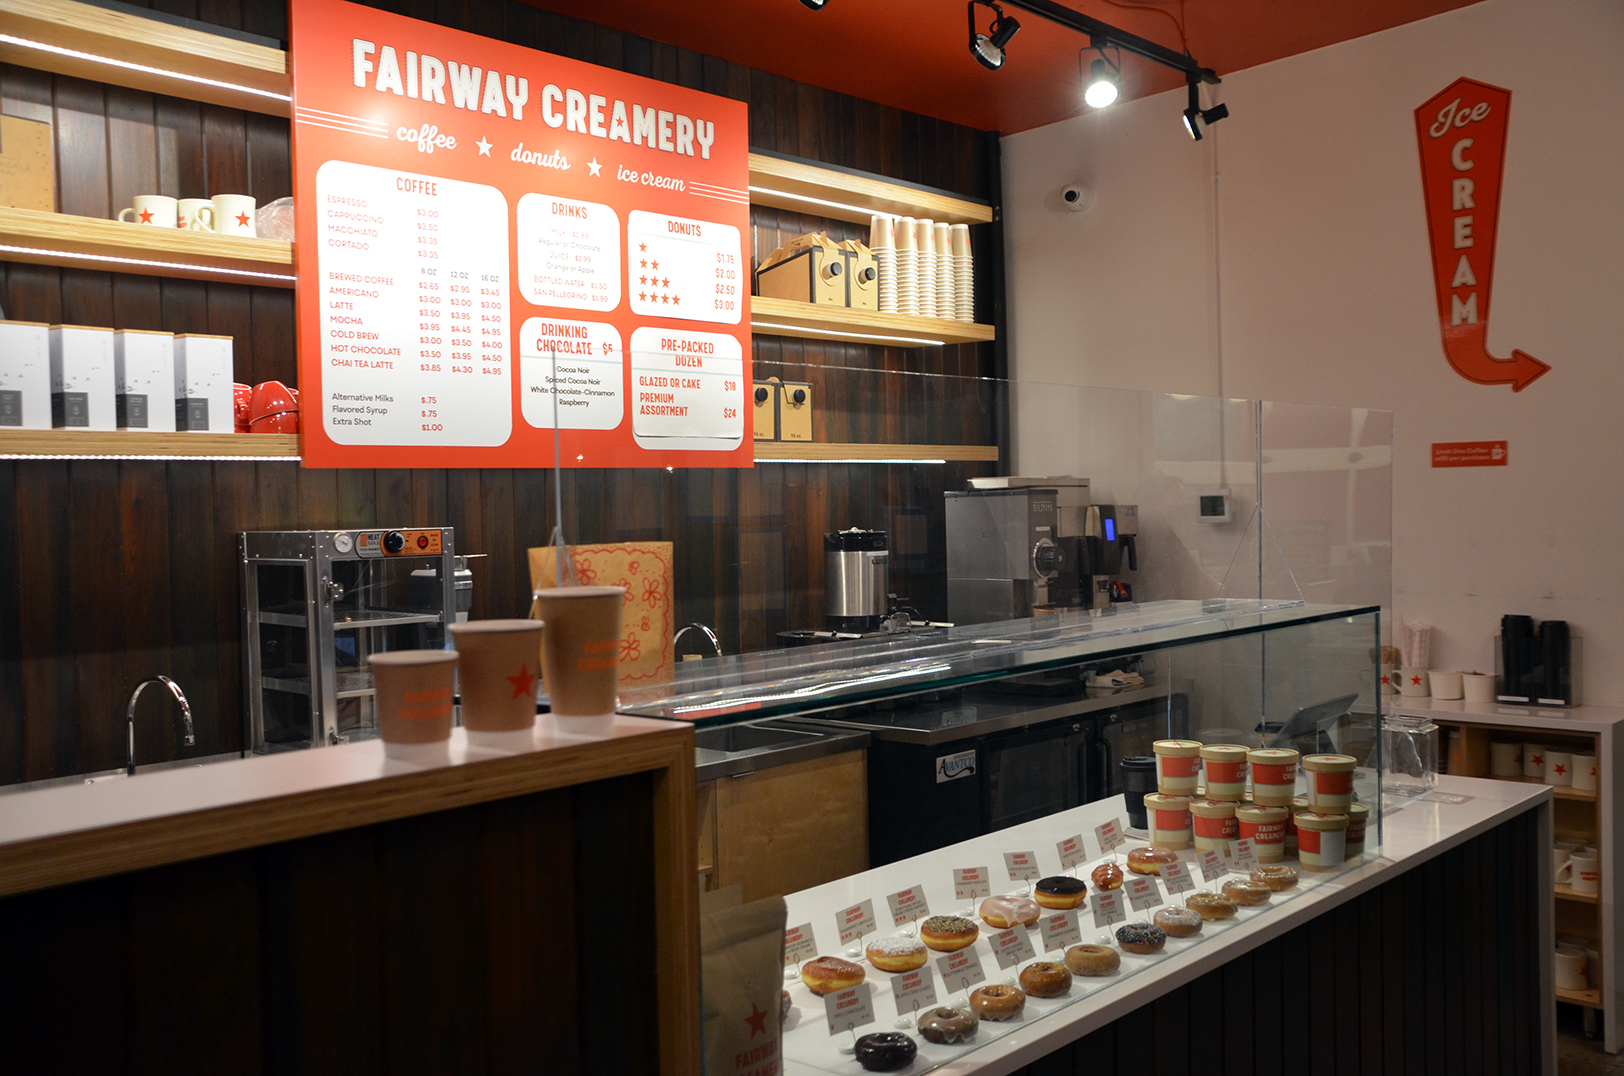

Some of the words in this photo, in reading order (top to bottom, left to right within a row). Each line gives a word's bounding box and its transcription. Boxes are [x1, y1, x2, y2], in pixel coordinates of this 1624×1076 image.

[352, 37, 529, 121] FAIRWAY
[542, 83, 715, 160] CREAMERY
[1429, 97, 1492, 138] Ice
[396, 123, 457, 154] coffee
[510, 142, 571, 171] donuts
[617, 164, 639, 184] ice
[641, 171, 686, 192] cream
[397, 177, 437, 196] COFFEE
[328, 195, 368, 208] ESPRESSO
[417, 209, 439, 218] $3.00
[552, 202, 588, 220] DRINKS
[328, 210, 384, 224] CAPPUCCINO
[418, 222, 438, 232] $3.50
[668, 220, 702, 237] DONUTS
[328, 225, 378, 237] MACCHIATO
[418, 236, 438, 245] $3.35
[1450, 137, 1479, 327] CREAM
[328, 239, 369, 250] CORTADO
[418, 250, 438, 259] $3.35
[575, 254, 592, 263] $1.99
[716, 253, 734, 264] $1.75
[427, 268, 437, 276] OZ
[481, 274, 489, 282] 16
[534, 275, 562, 286] BOTTLED
[563, 278, 585, 288] WATER
[715, 268, 735, 280] $2.00
[329, 272, 362, 283] BREWED
[364, 275, 394, 286] COFFEE
[418, 282, 439, 290] $2.65
[450, 285, 470, 293] $2.95
[481, 288, 500, 296] $3.45
[715, 284, 735, 295] $2.50
[329, 287, 379, 298] AMERICANO
[419, 295, 441, 304] $3.00
[451, 298, 472, 307] $3.00
[481, 301, 502, 310] $3.00
[549, 289, 588, 300] PELLEGRINO
[330, 301, 354, 310] LATTE
[419, 309, 440, 318] $3.50
[451, 312, 470, 320] $3.95
[481, 314, 501, 323] $4.50
[714, 299, 734, 310] $3.00
[330, 316, 363, 325] MOCHA
[419, 323, 440, 331] $3.95
[451, 326, 471, 334] $4.45
[482, 328, 501, 336] $4.95
[541, 323, 588, 339] DRINKING
[330, 330, 355, 339] COLD
[357, 332, 379, 340] BREW
[420, 336, 442, 345] $3.00
[451, 339, 472, 347] $3.50
[482, 341, 502, 349] $4.00
[536, 338, 592, 355] CHOCOLATE
[661, 338, 714, 354] PRE-PACKED
[331, 344, 348, 353] HOT
[350, 346, 401, 356] CHOCOLATE
[420, 350, 441, 358] $3.50
[452, 352, 472, 360] $3.95
[482, 354, 502, 362] $4.50
[675, 354, 702, 368] DOZEN
[331, 358, 353, 367] CHAI
[355, 360, 368, 368] TEA
[370, 361, 394, 369] LATTE
[420, 364, 441, 372] $3.85
[452, 365, 473, 374] $4.30
[482, 367, 502, 375] $4.95
[557, 366, 576, 374] Cocoa
[578, 366, 590, 374] Noir
[545, 376, 566, 385] Spiced
[568, 377, 586, 385] Cocoa
[588, 378, 601, 386] Noir
[639, 376, 668, 387] GLAZED
[670, 377, 680, 388] OR
[682, 378, 700, 389] CAKE
[724, 381, 736, 391] $18
[332, 393, 374, 402] Alternative
[375, 394, 394, 402] Milks
[530, 386, 548, 394] White
[550, 387, 615, 397] Chocolate-Cinnamon
[640, 392, 674, 403] PREMIUM
[332, 405, 364, 414] Flavored
[366, 406, 388, 416] Syrup
[559, 399, 589, 408] Raspberry
[640, 404, 688, 417] ASSORTMENT
[724, 408, 736, 419] $24
[333, 418, 352, 426] Extra
[354, 418, 372, 426] Shot
[422, 424, 443, 432] $1.00
[1033, 503, 1053, 512] BUNN
